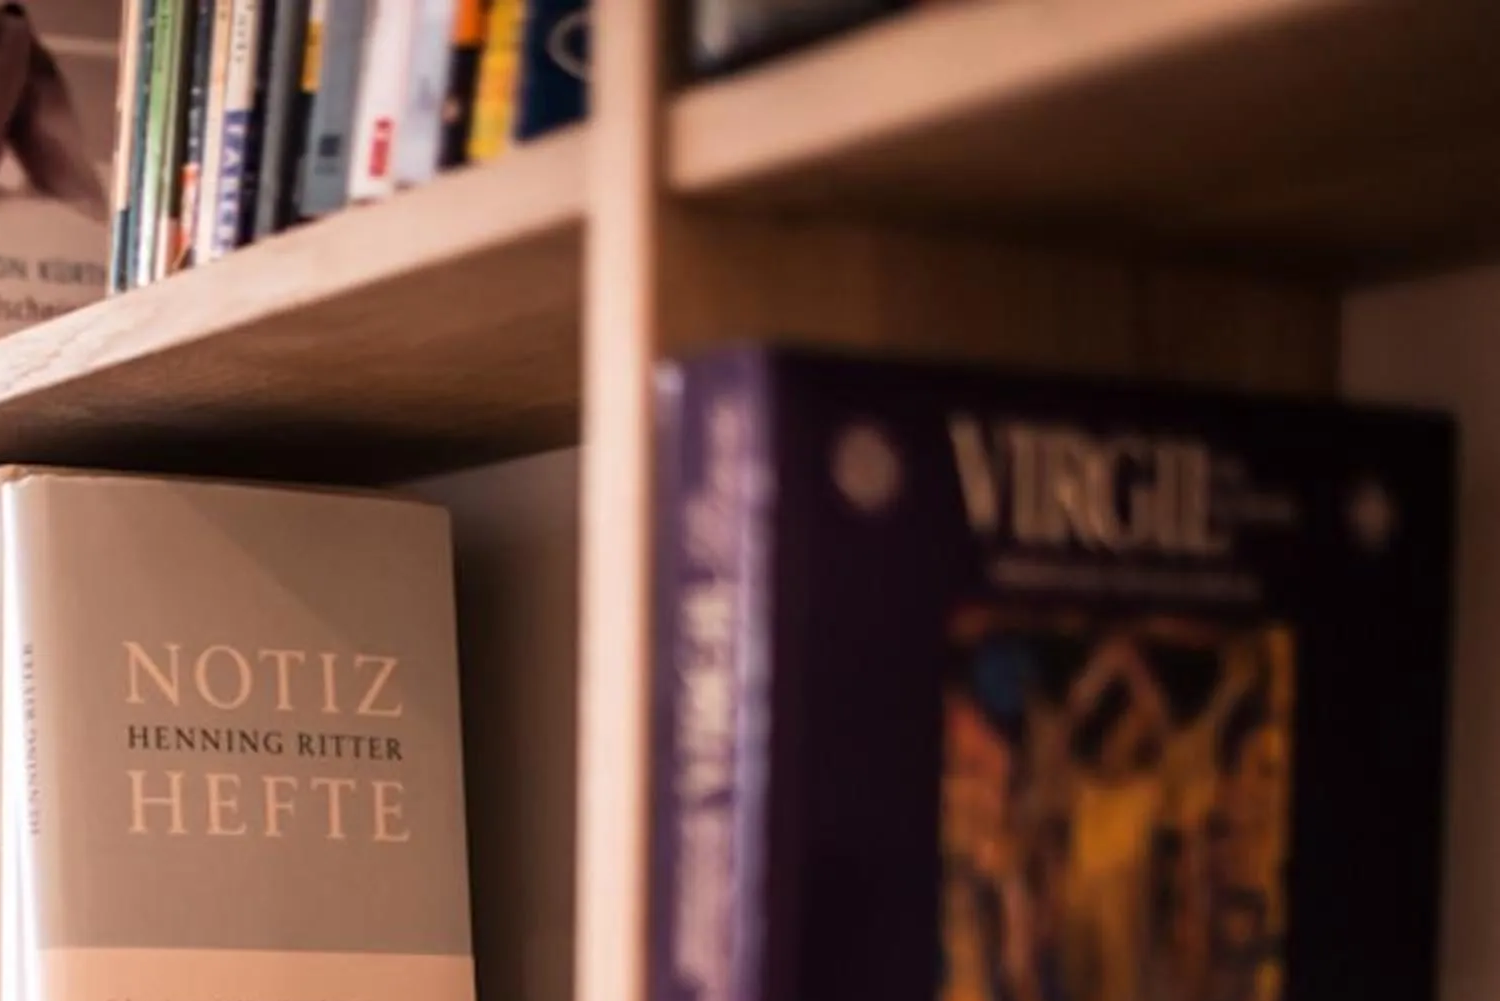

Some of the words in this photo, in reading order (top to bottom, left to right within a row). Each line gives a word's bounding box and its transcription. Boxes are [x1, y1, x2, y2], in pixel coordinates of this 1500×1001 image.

[948, 412, 1232, 556] VIRGIL
[121, 640, 404, 718] NOTIZ
[127, 725, 284, 755] HENNING
[297, 732, 403, 761] RITTER
[126, 769, 411, 843] HEFTE
